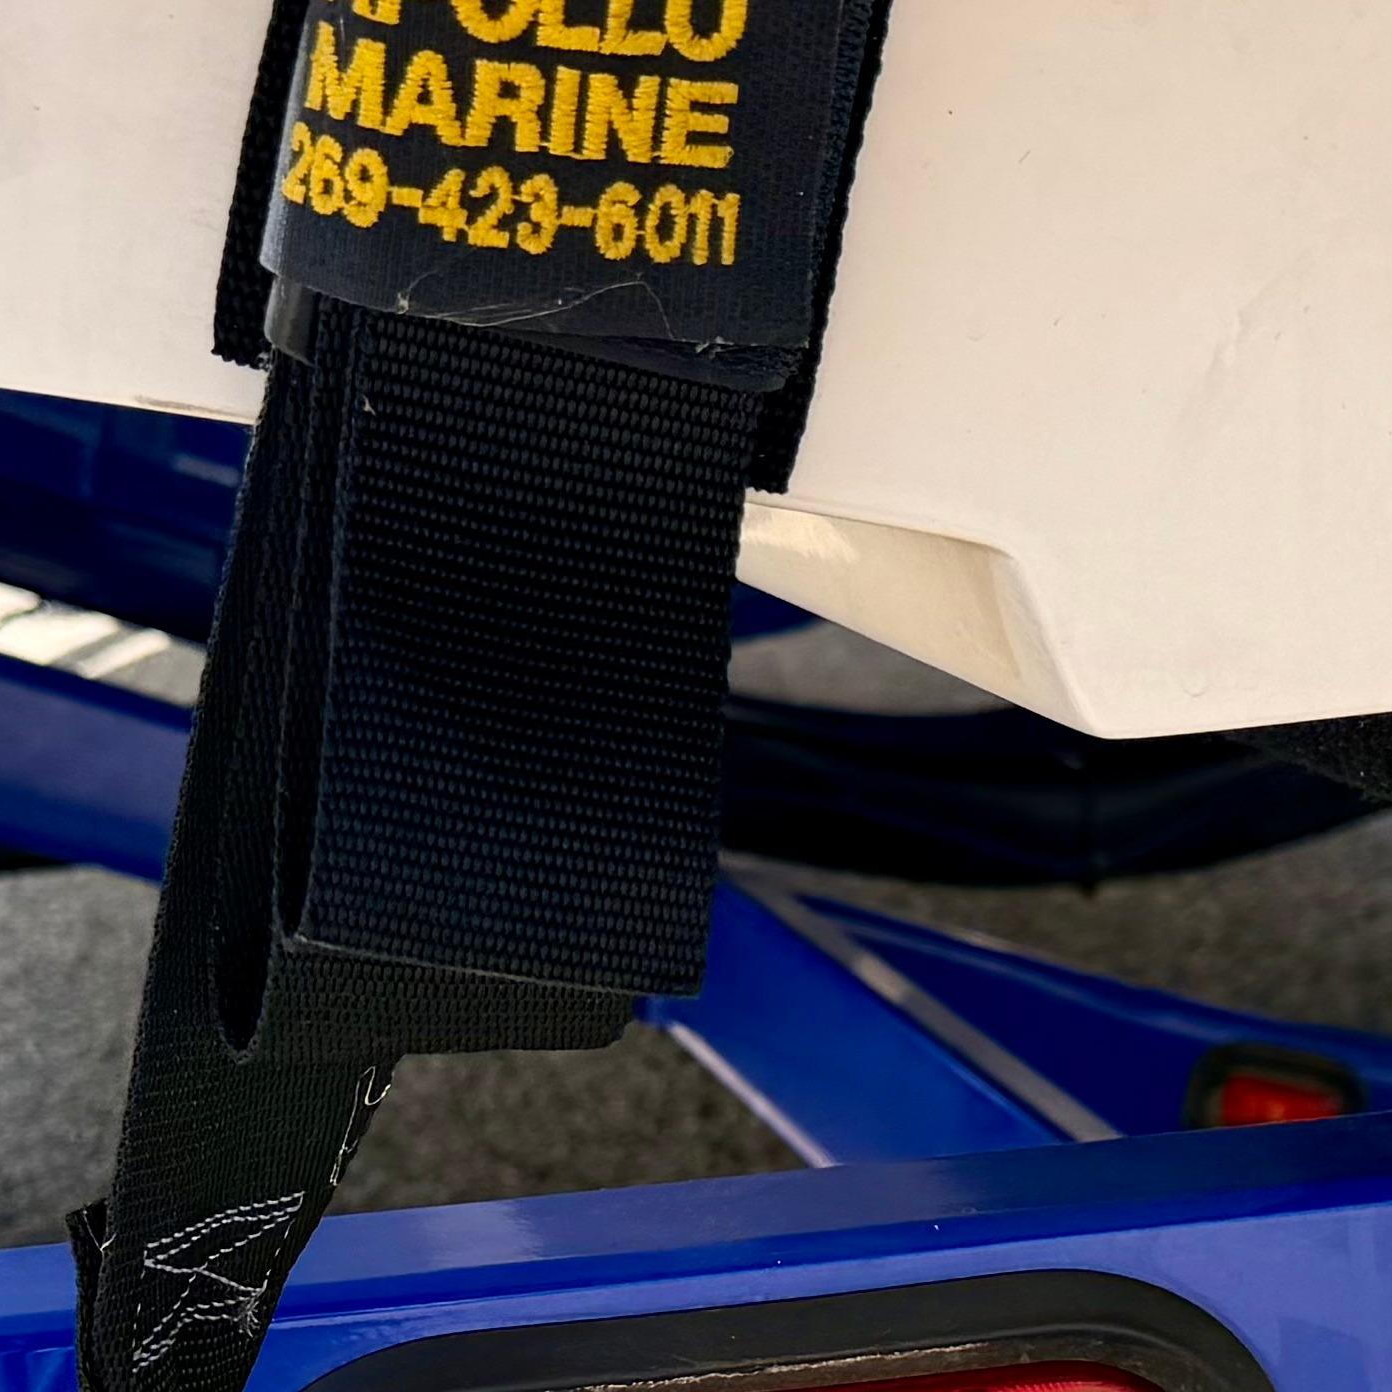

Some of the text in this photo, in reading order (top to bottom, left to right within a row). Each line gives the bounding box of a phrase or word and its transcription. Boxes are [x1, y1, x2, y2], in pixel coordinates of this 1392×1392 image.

[305, 21, 739, 168] MARINE
[325, 0, 747, 61] OLLO
[282, 121, 740, 265] 269-423-6011
